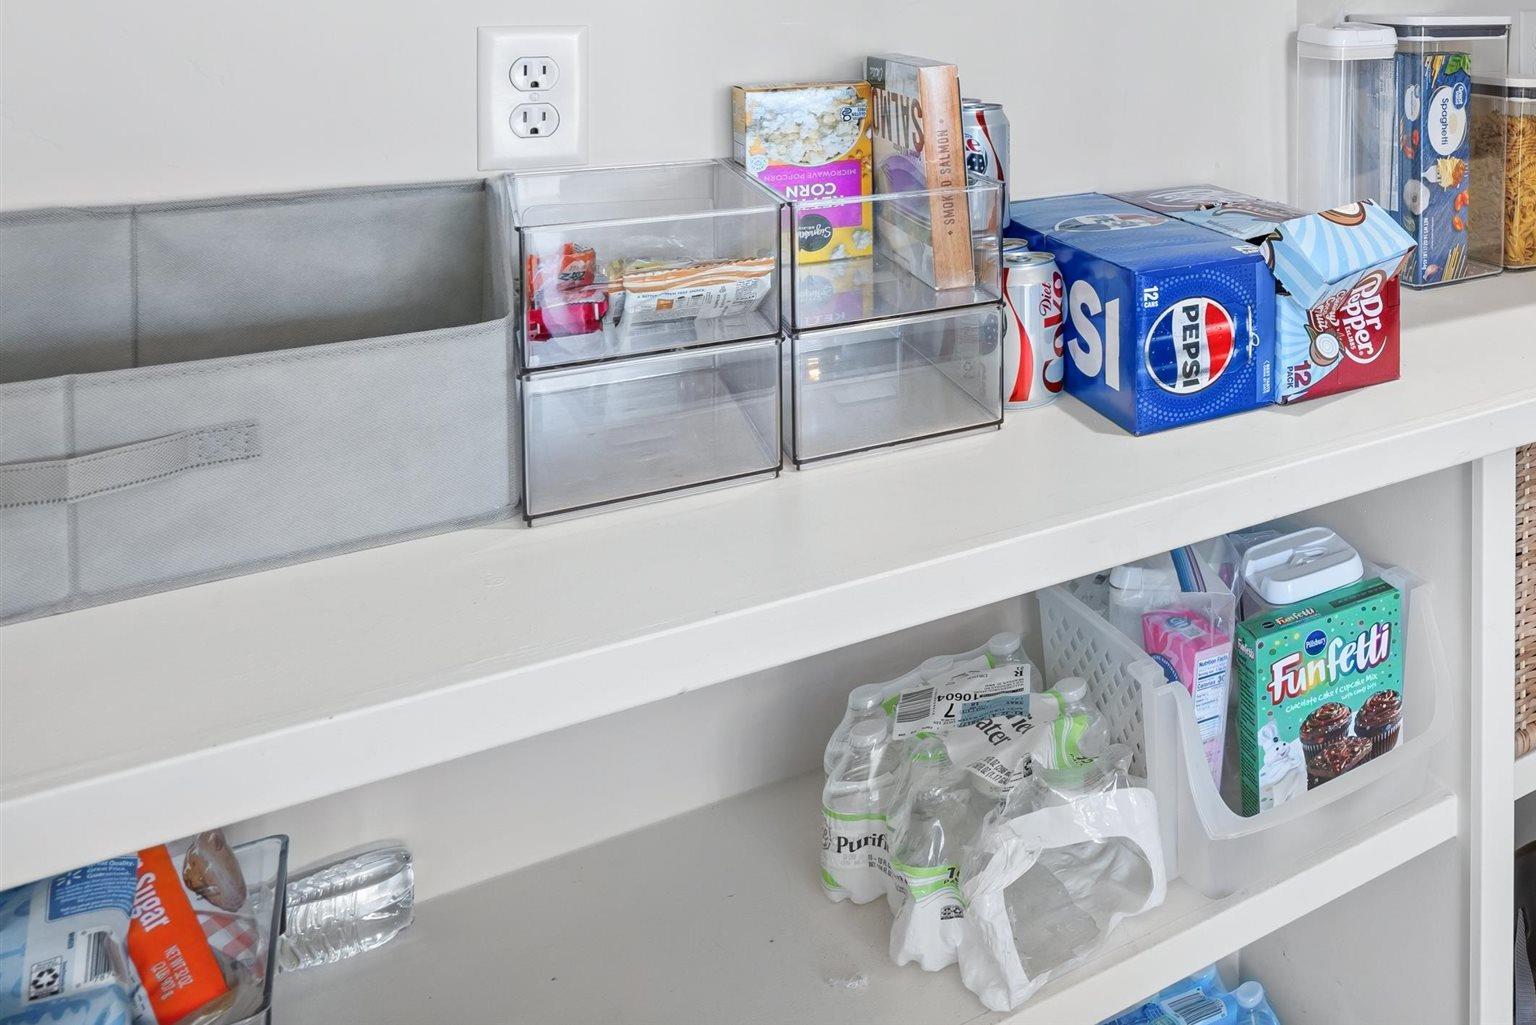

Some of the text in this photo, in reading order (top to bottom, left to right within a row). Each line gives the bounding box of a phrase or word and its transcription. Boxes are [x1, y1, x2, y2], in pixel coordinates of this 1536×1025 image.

[1440, 98, 1450, 145] Spaghetti
[764, 168, 857, 182] MICROWAVE POPCORN
[935, 128, 956, 226] SMOKD SALMON
[786, 182, 837, 198] CORN
[1039, 282, 1052, 316] Diet
[1143, 285, 1159, 301] 12
[1067, 279, 1120, 392] SI
[1181, 303, 1201, 391] PEPSI
[1286, 366, 1294, 389] PACK
[1294, 360, 1312, 388] 12
[1275, 607, 1317, 625] Funfetti
[1305, 637, 1326, 649] Pillsbury
[1267, 621, 1391, 706] Funfetti
[937, 692, 981, 702] 10604
[1318, 689, 1335, 701] Cake
[1365, 673, 1379, 683] Mix
[944, 703, 956, 718] 7
[132, 872, 171, 933] Sugar
